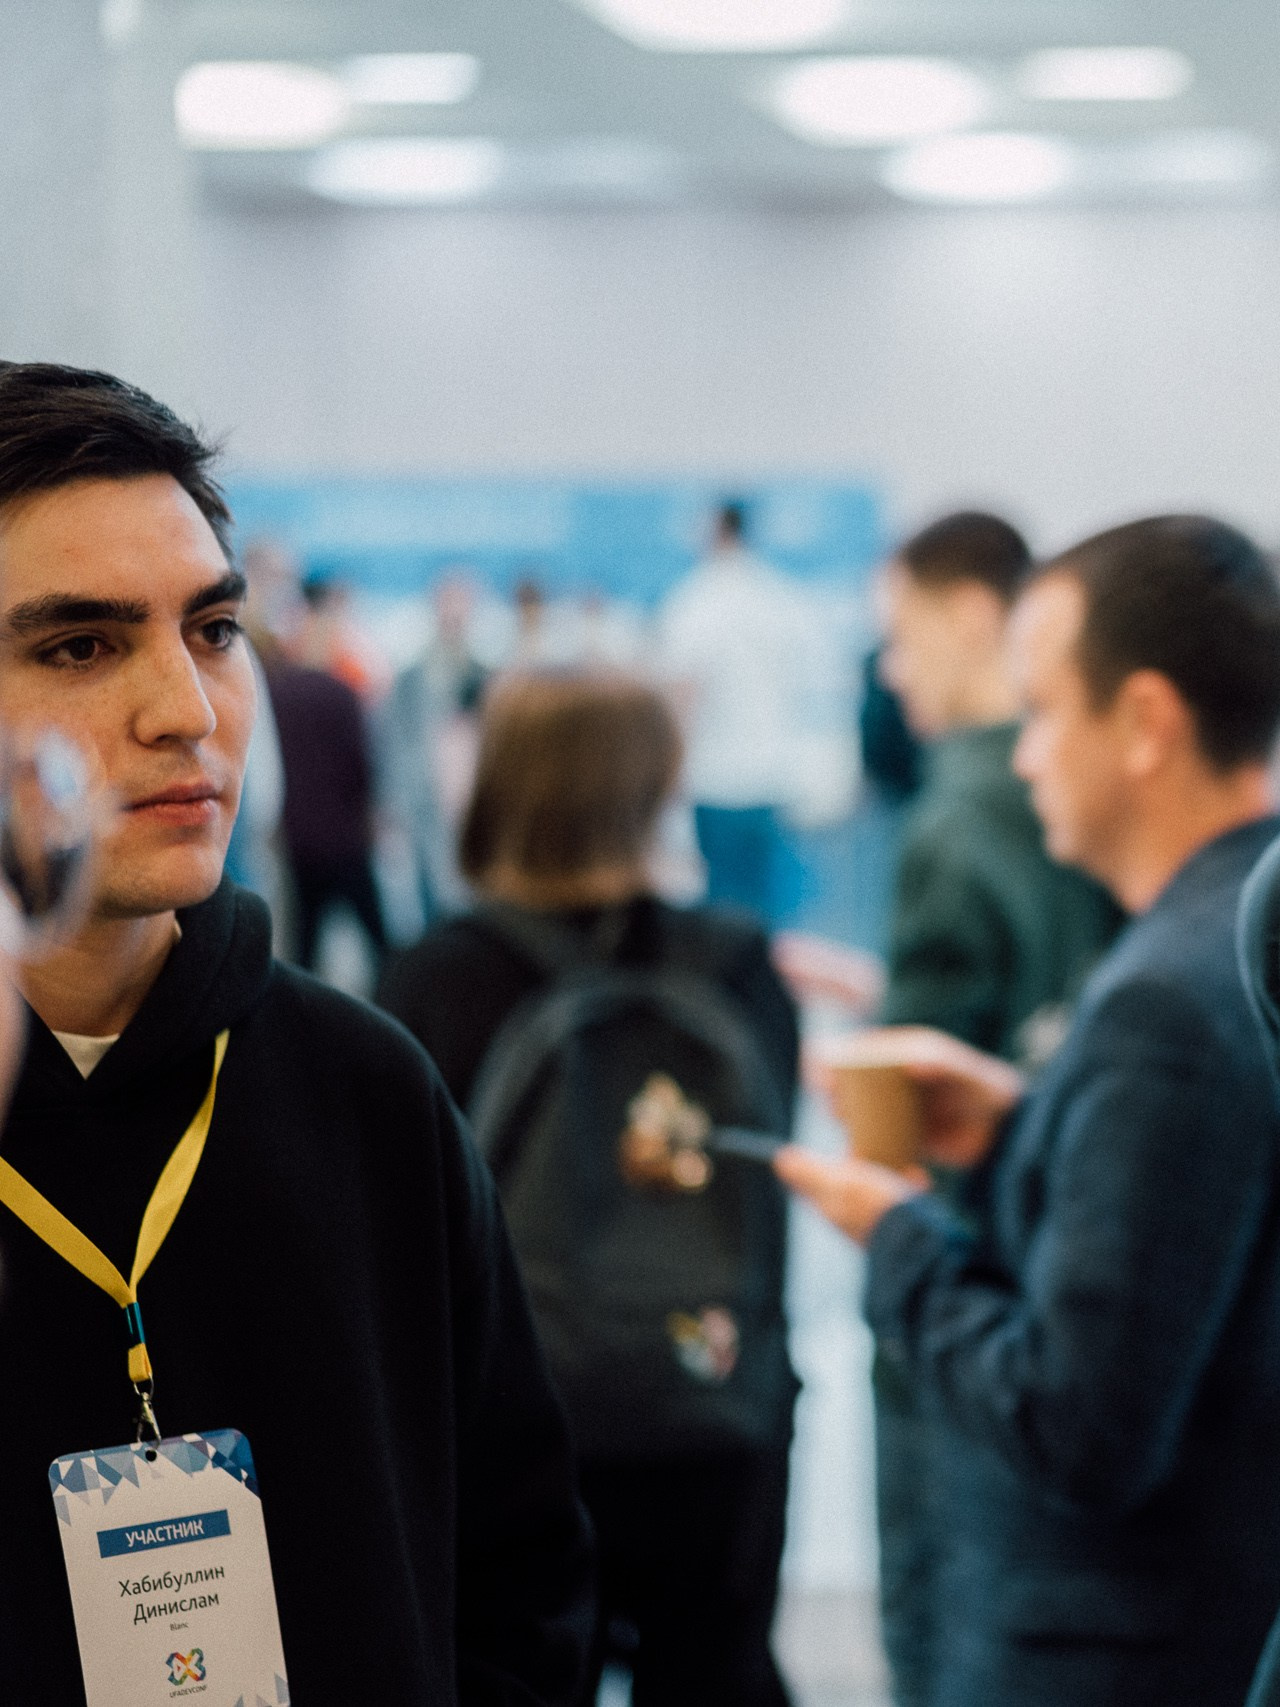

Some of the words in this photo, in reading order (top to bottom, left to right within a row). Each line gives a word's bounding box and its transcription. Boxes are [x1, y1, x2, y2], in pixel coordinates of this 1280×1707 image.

[125, 1519, 205, 1548] УЧАСТНИК
[118, 1566, 225, 1597] Хабибуллин
[133, 1593, 220, 1625] Динислам
